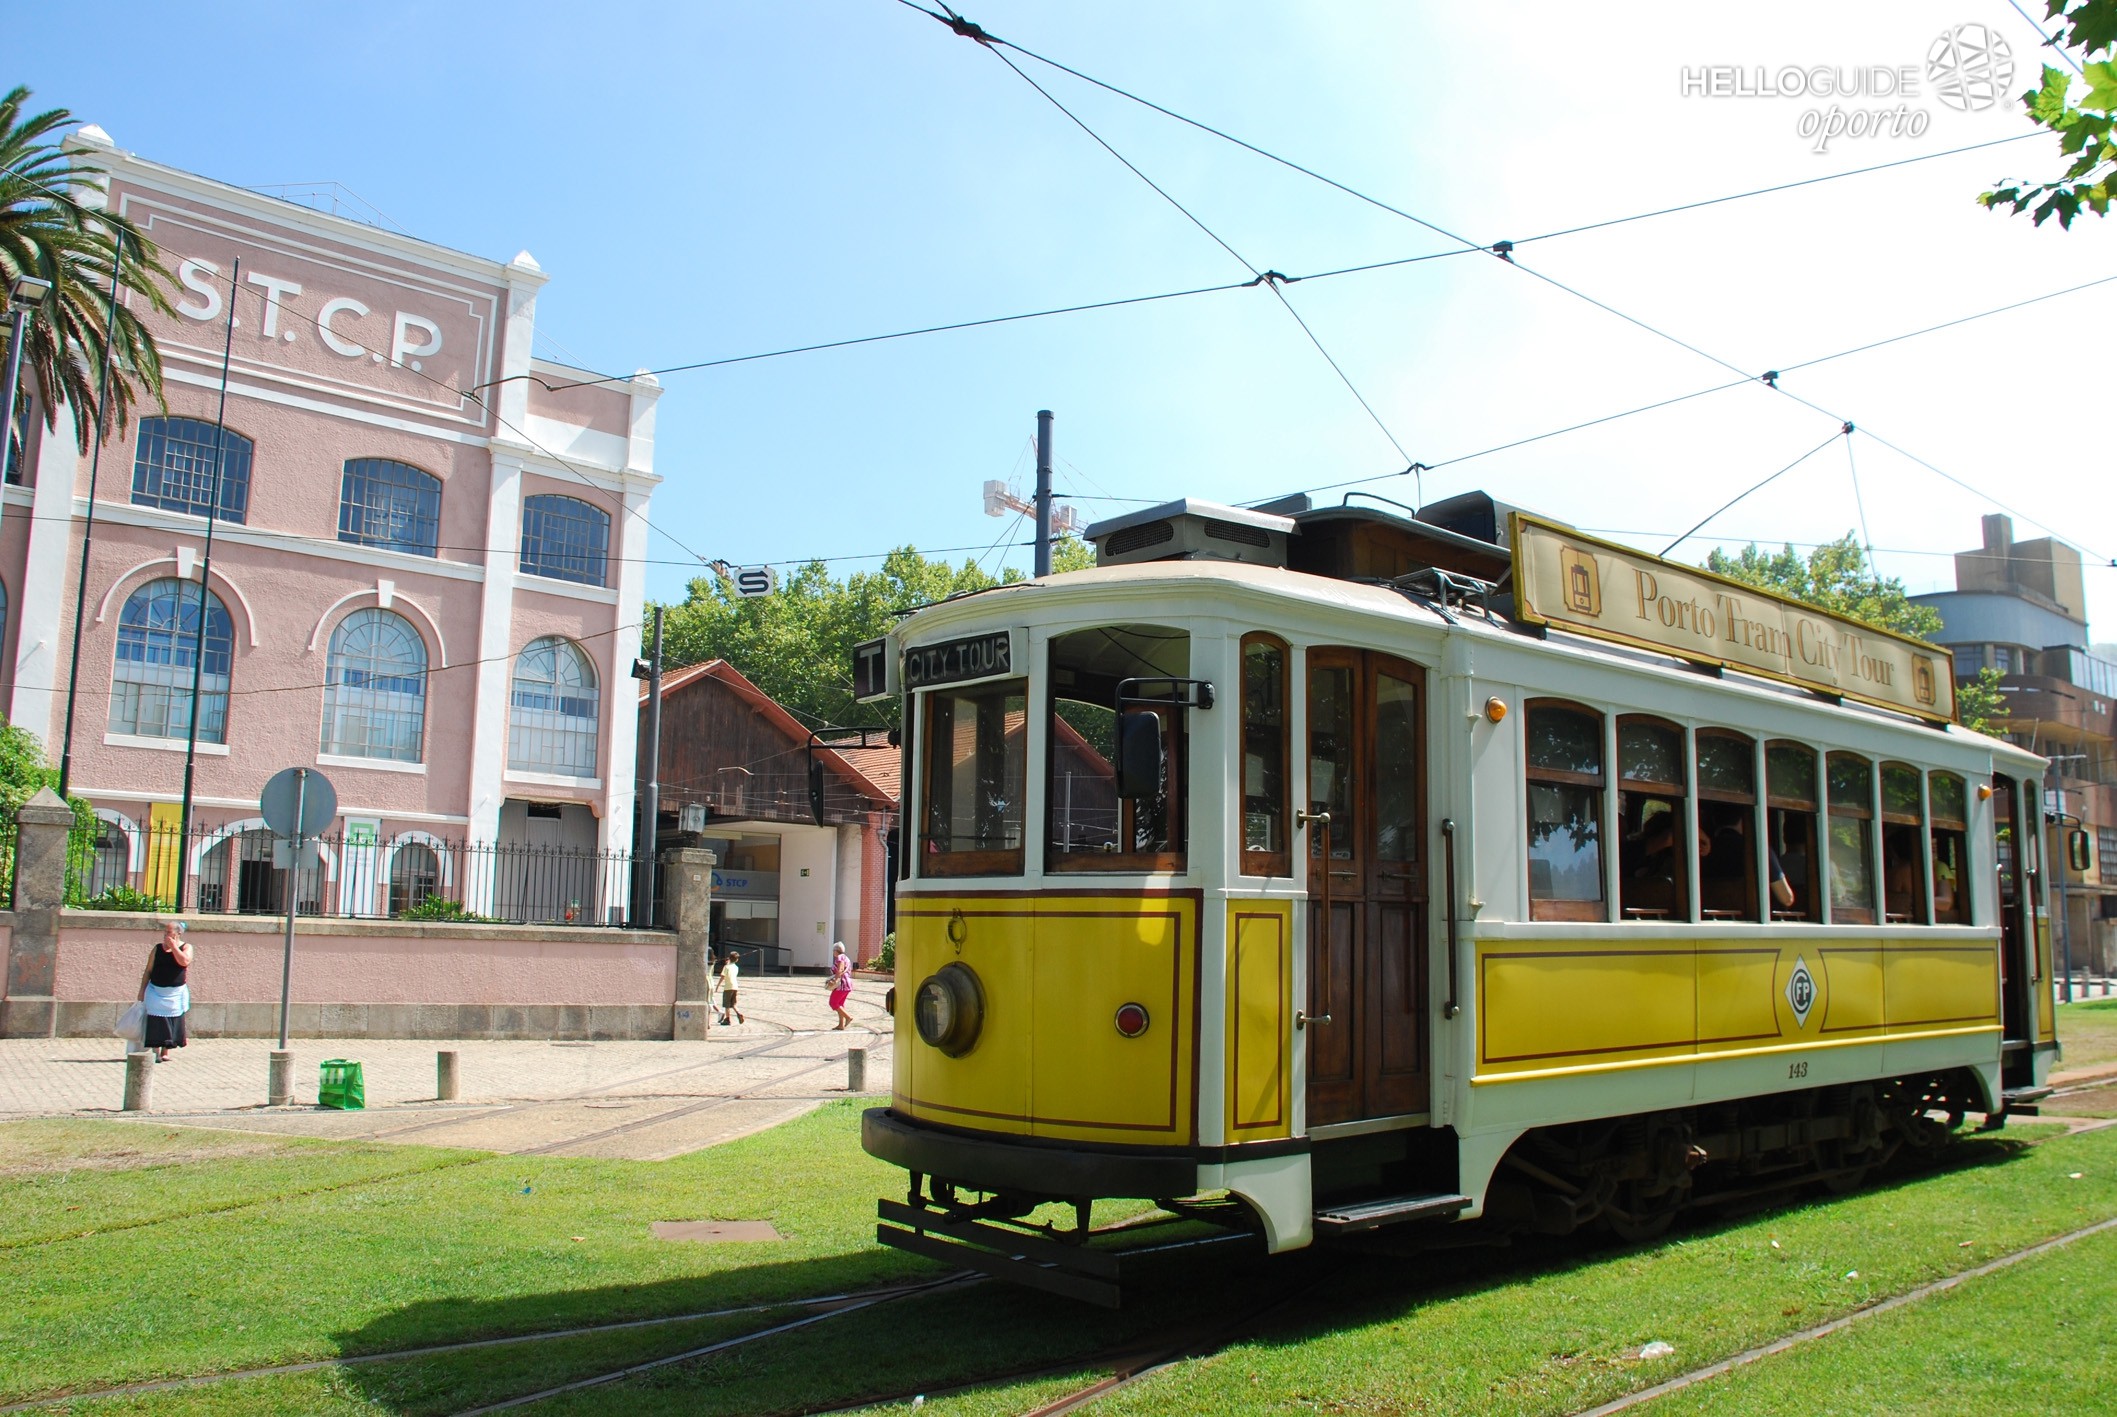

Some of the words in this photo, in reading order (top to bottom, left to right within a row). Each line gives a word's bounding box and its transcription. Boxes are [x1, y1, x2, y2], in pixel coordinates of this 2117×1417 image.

[1632, 568, 1716, 639] Porto
[1715, 593, 1793, 659] Tram
[1796, 618, 1841, 686] City
[1842, 632, 1895, 687] Tour
[859, 644, 882, 693] T
[909, 647, 951, 682] CITY
[956, 636, 1009, 675] TOUR
[726, 879, 748, 887] STCP
[1788, 1061, 1808, 1079] 143
